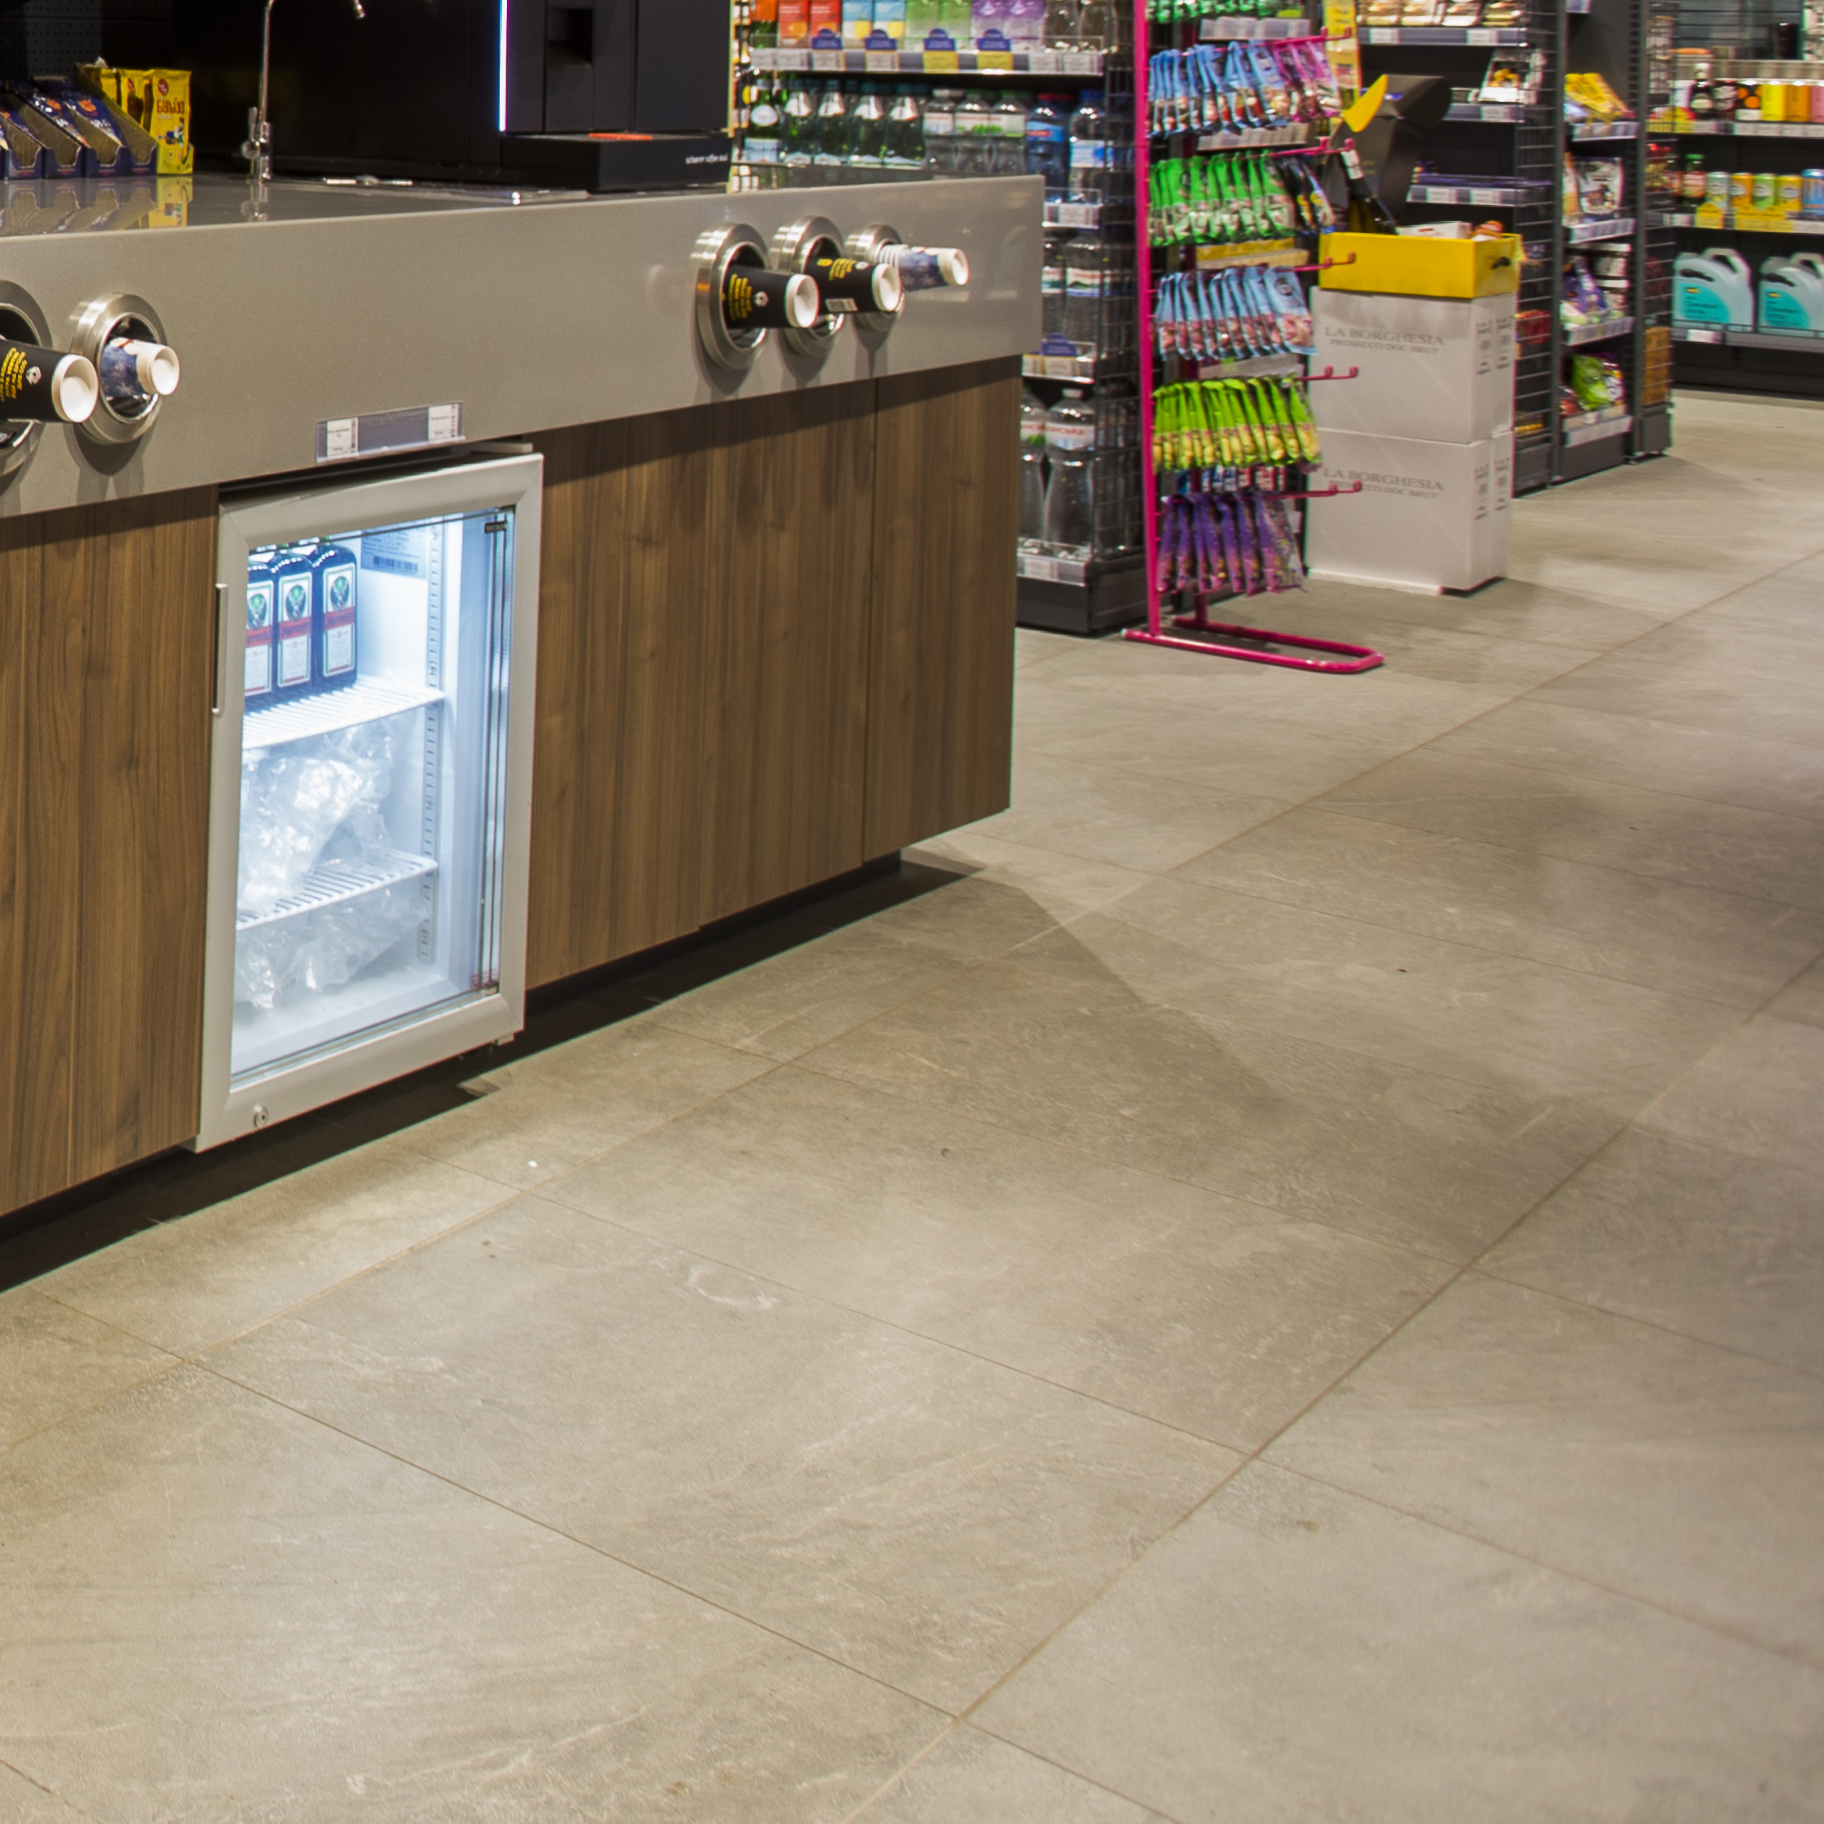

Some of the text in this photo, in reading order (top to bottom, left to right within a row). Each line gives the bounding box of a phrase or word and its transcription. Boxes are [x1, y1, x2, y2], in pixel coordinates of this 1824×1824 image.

[1325, 326, 1445, 346] LA BORGHESIA
[1347, 470, 1445, 492] BORGHESIA
